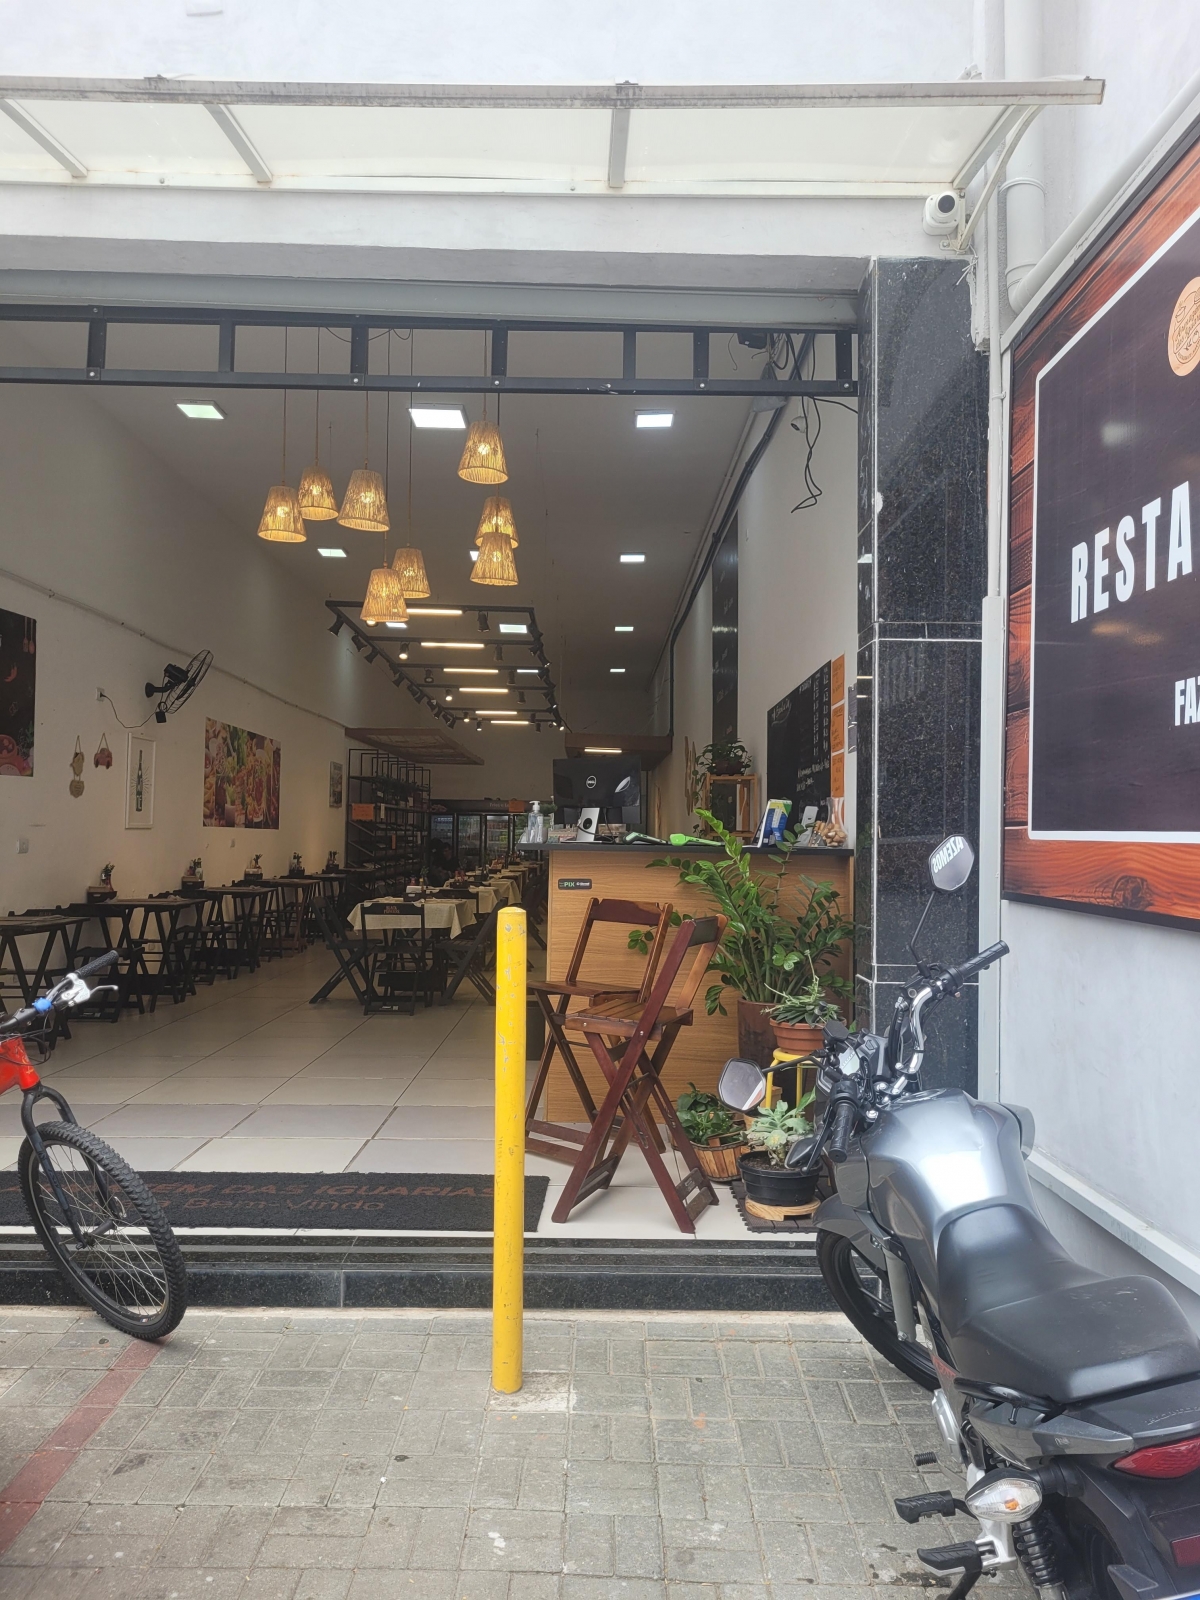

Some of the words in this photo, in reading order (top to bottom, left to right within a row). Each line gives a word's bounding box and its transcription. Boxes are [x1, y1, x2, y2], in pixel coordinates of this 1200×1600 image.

[1071, 481, 1192, 623] RESTA
[1174, 676, 1200, 726] FA
[220, 1184, 309, 1194] DAS
